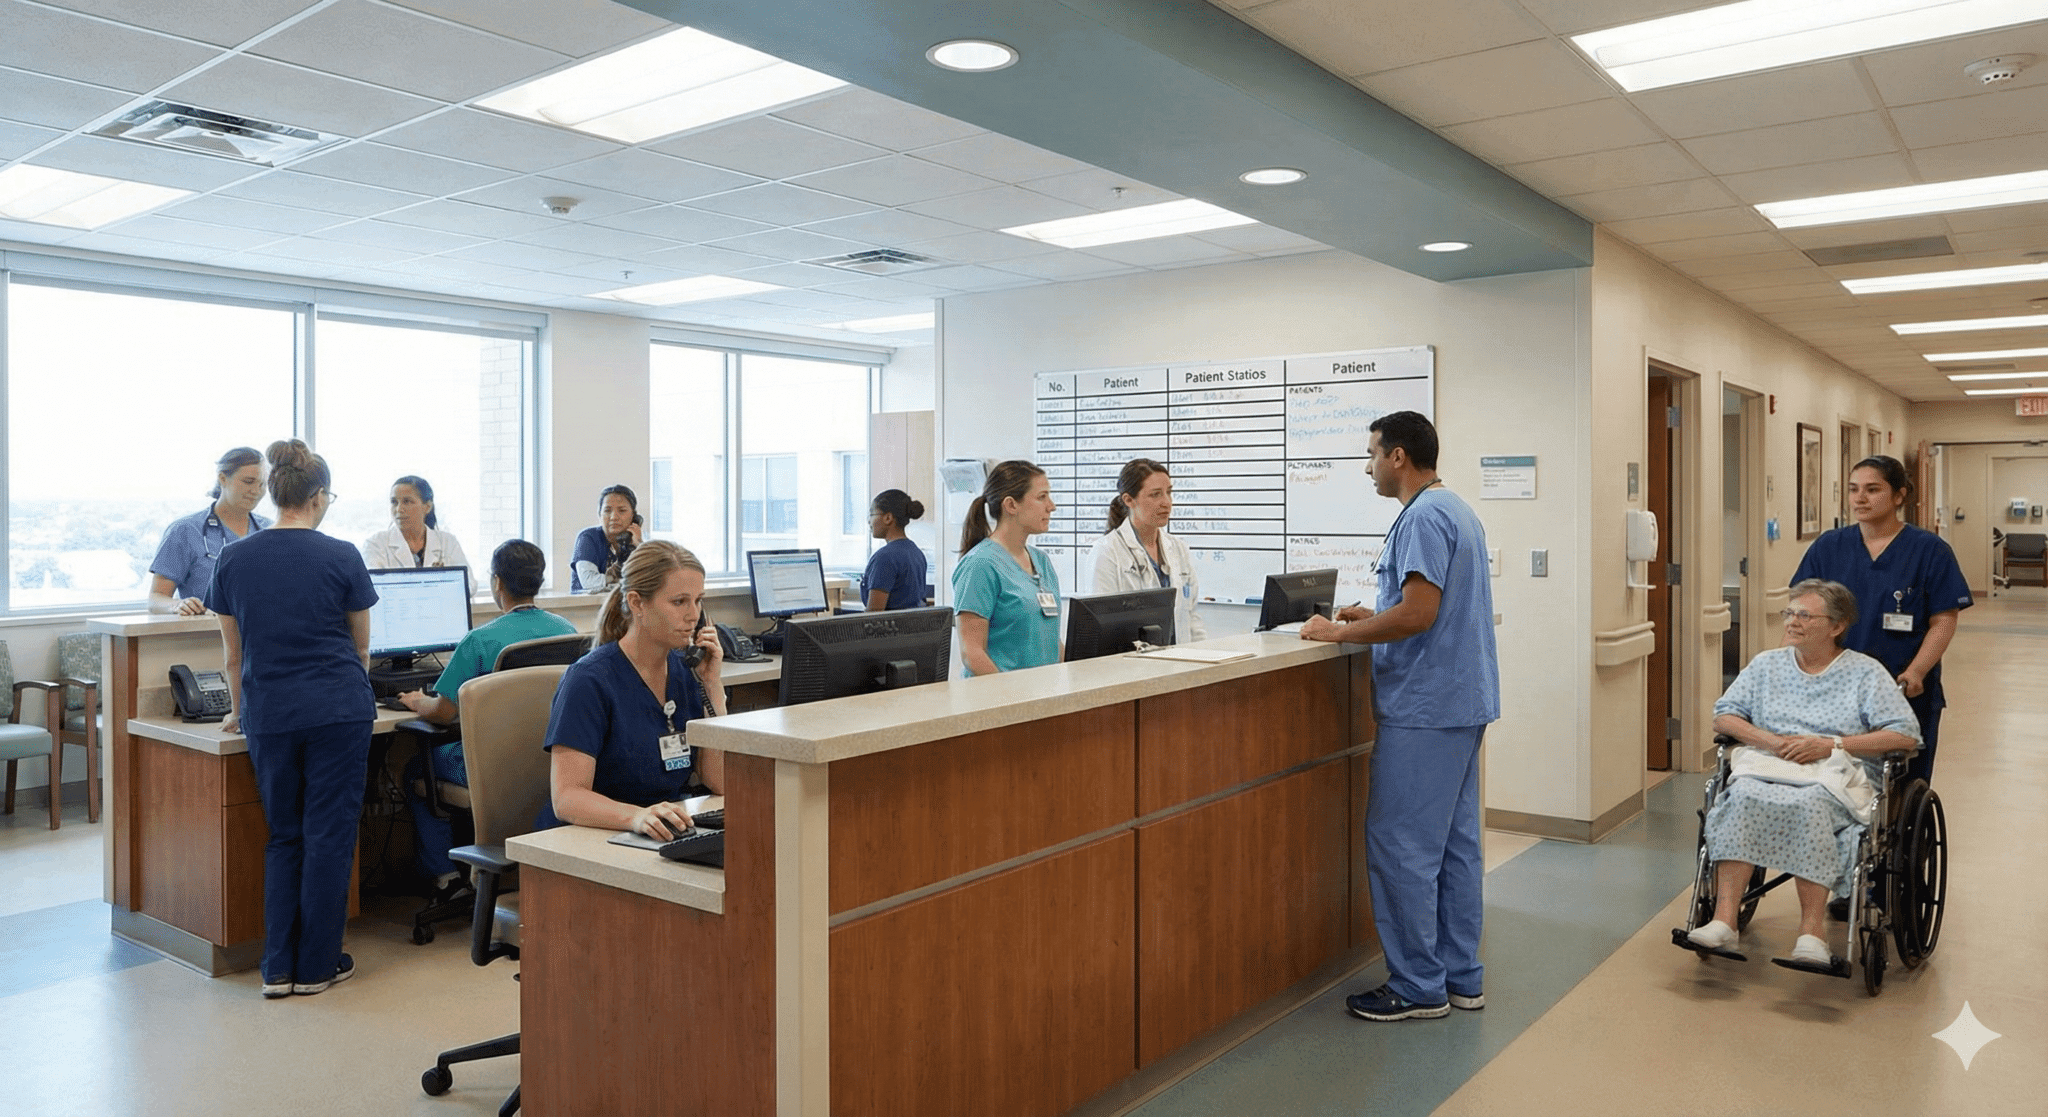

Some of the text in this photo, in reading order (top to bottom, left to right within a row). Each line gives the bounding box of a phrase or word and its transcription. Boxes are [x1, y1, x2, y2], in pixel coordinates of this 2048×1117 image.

[1332, 361, 1376, 374] Patient
[1104, 377, 1139, 388] Patient
[1185, 372, 1224, 383] Patient
[1049, 382, 1066, 393] No.
